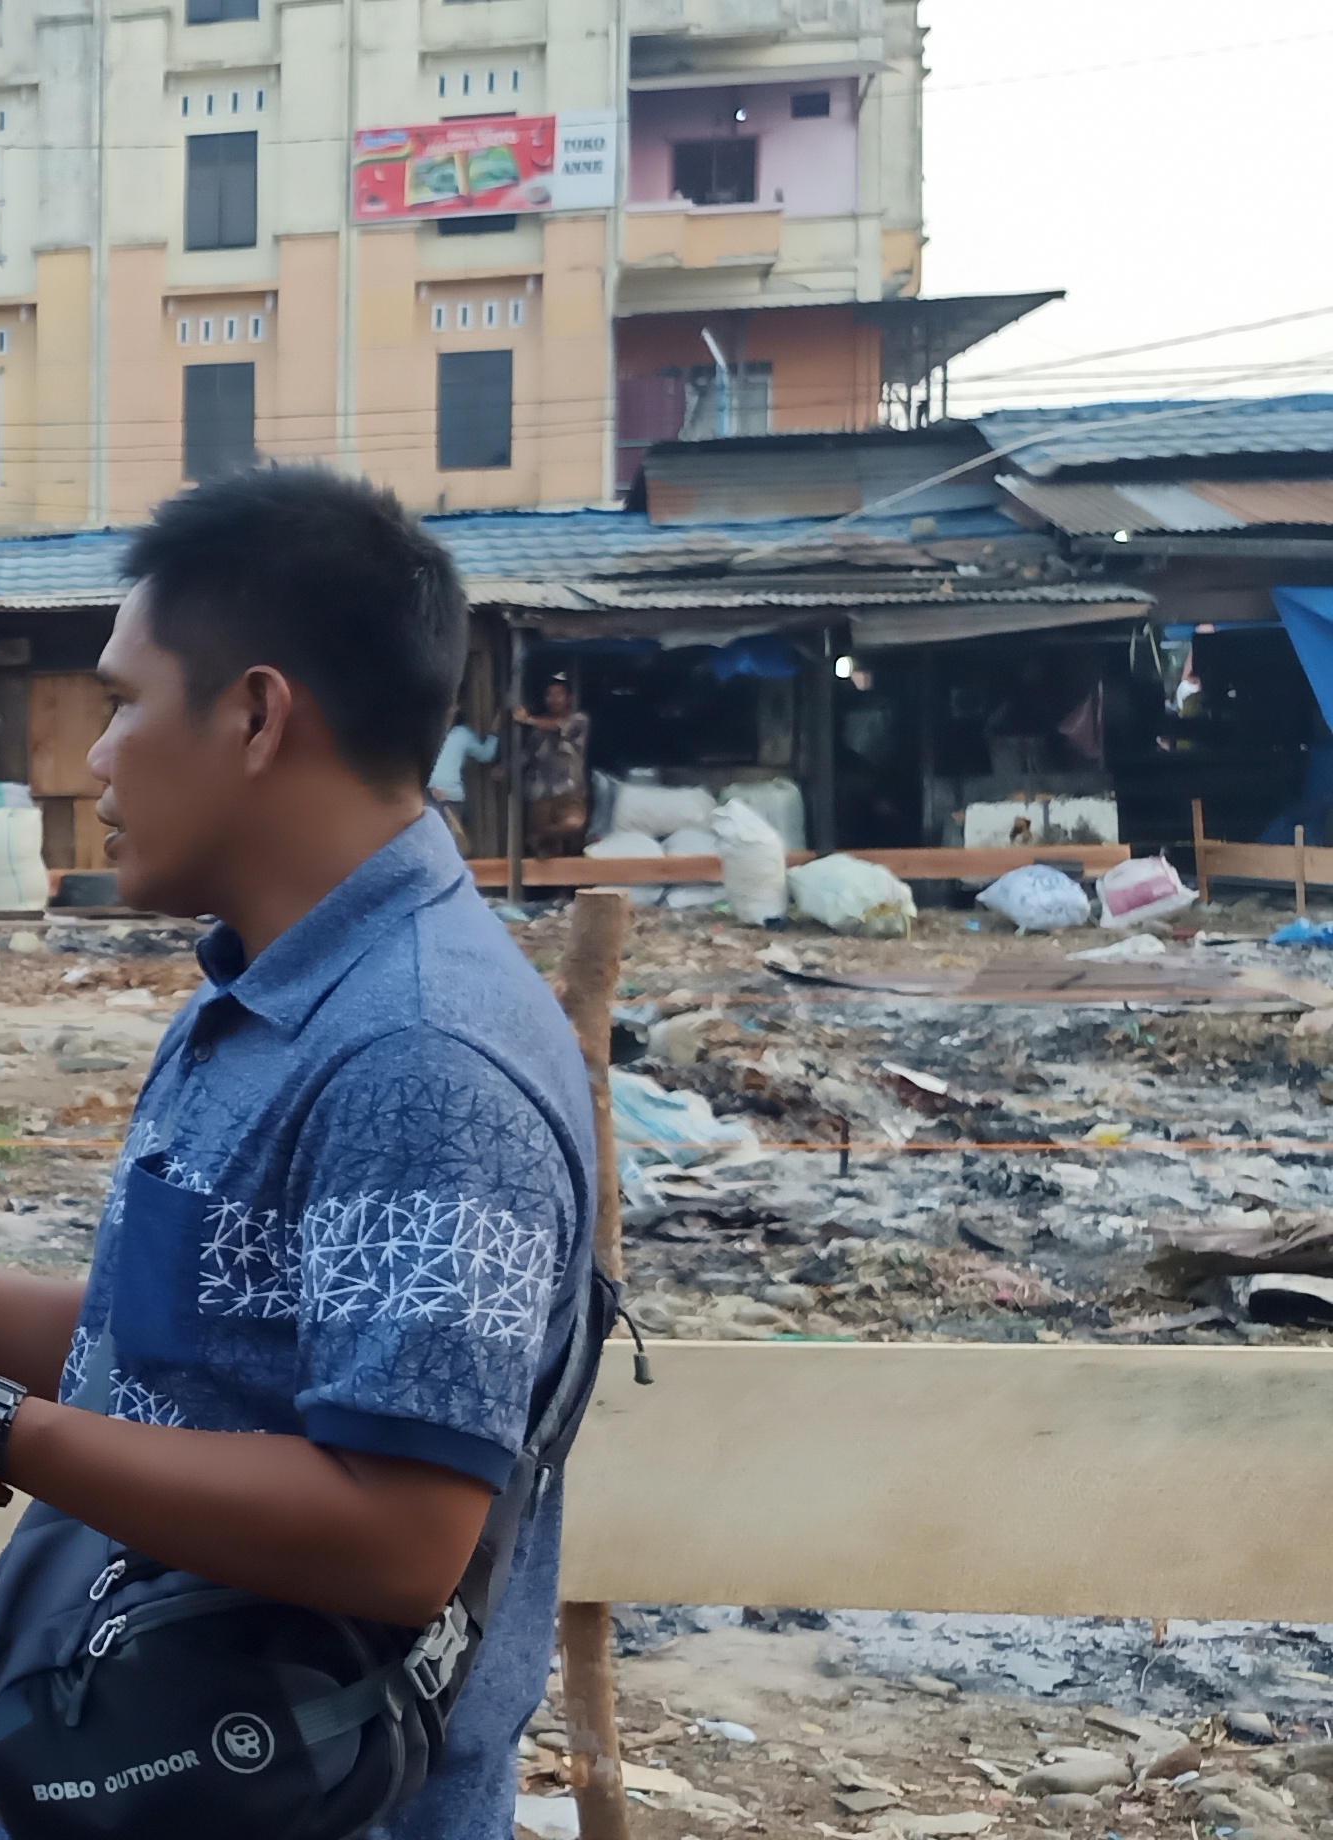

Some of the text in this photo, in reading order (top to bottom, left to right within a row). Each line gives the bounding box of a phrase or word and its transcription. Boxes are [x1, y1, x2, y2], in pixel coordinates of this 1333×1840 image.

[563, 137, 605, 153] TOKO
[32, 1749, 201, 1801] BOBO OUTDOOR
